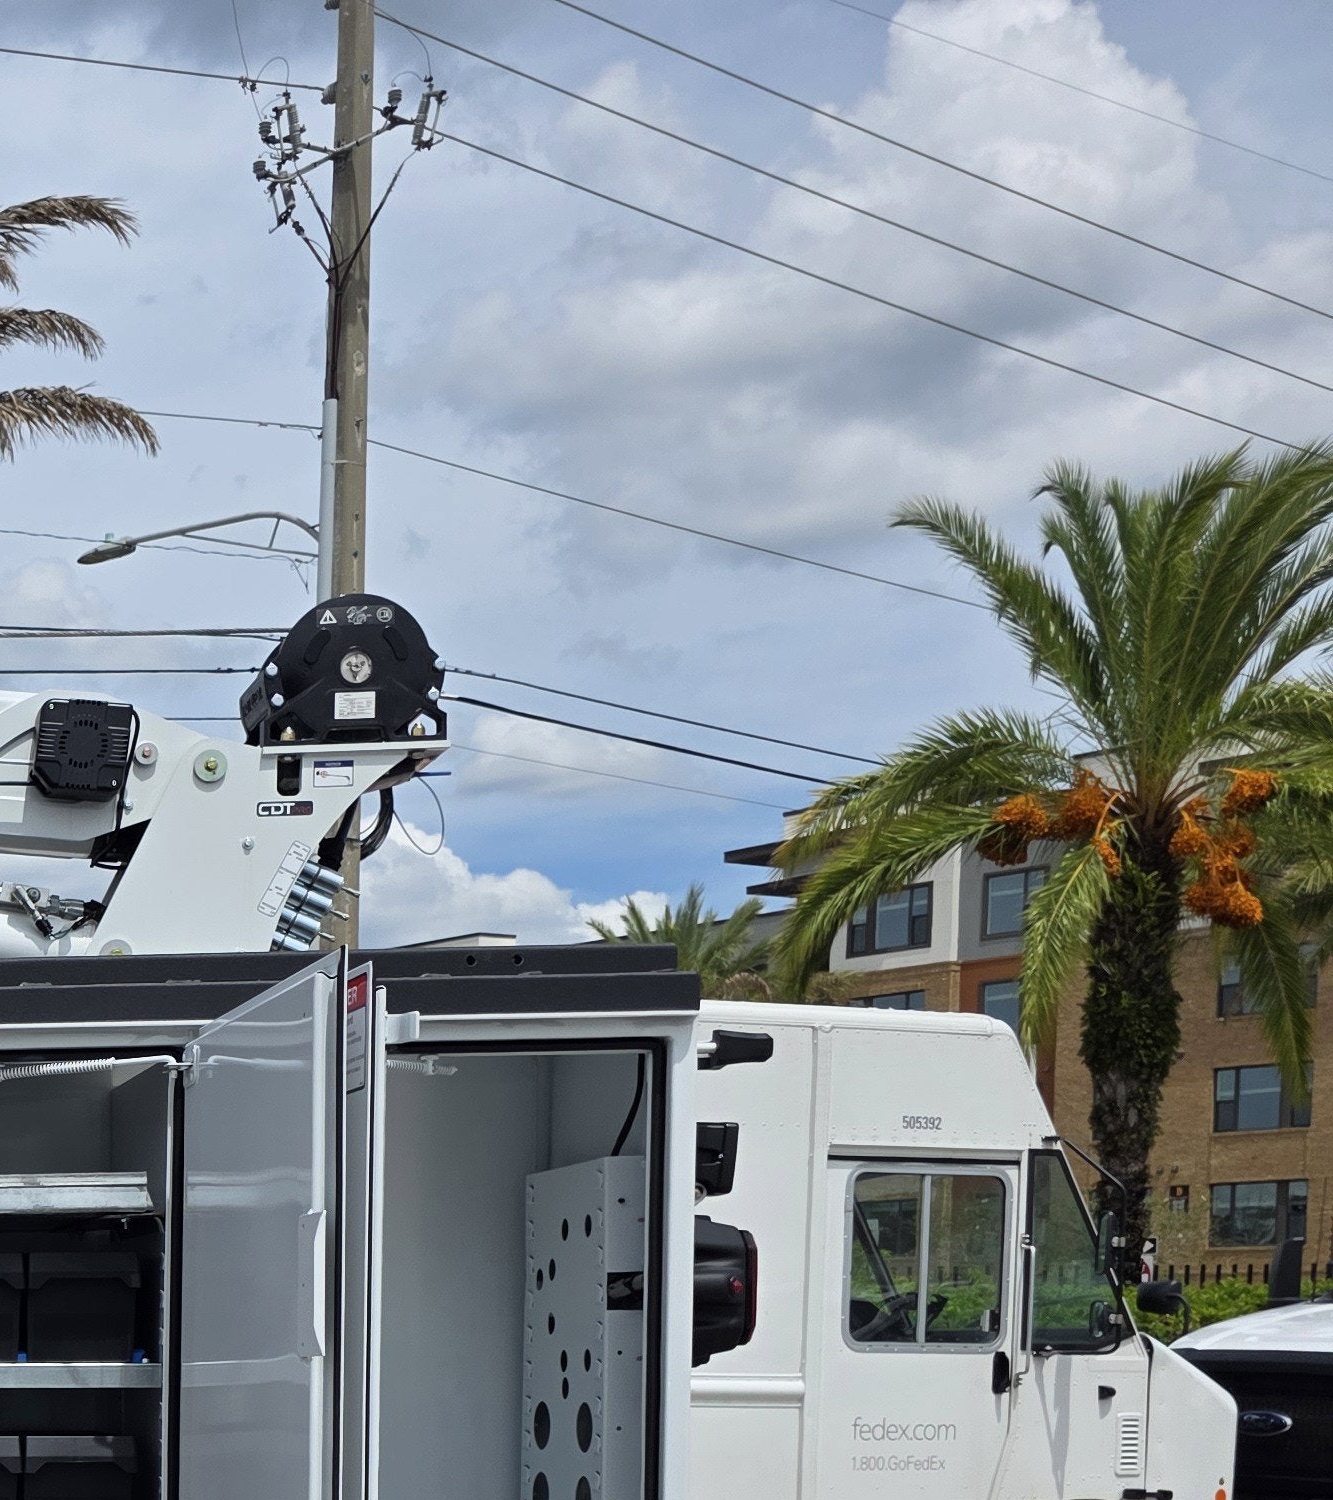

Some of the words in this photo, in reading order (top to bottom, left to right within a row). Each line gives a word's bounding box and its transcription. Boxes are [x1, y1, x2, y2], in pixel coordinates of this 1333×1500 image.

[902, 1115, 942, 1131] 505392
[852, 1416, 957, 1441] fedex.com
[851, 1455, 946, 1471] 1.800.GoFedEx
